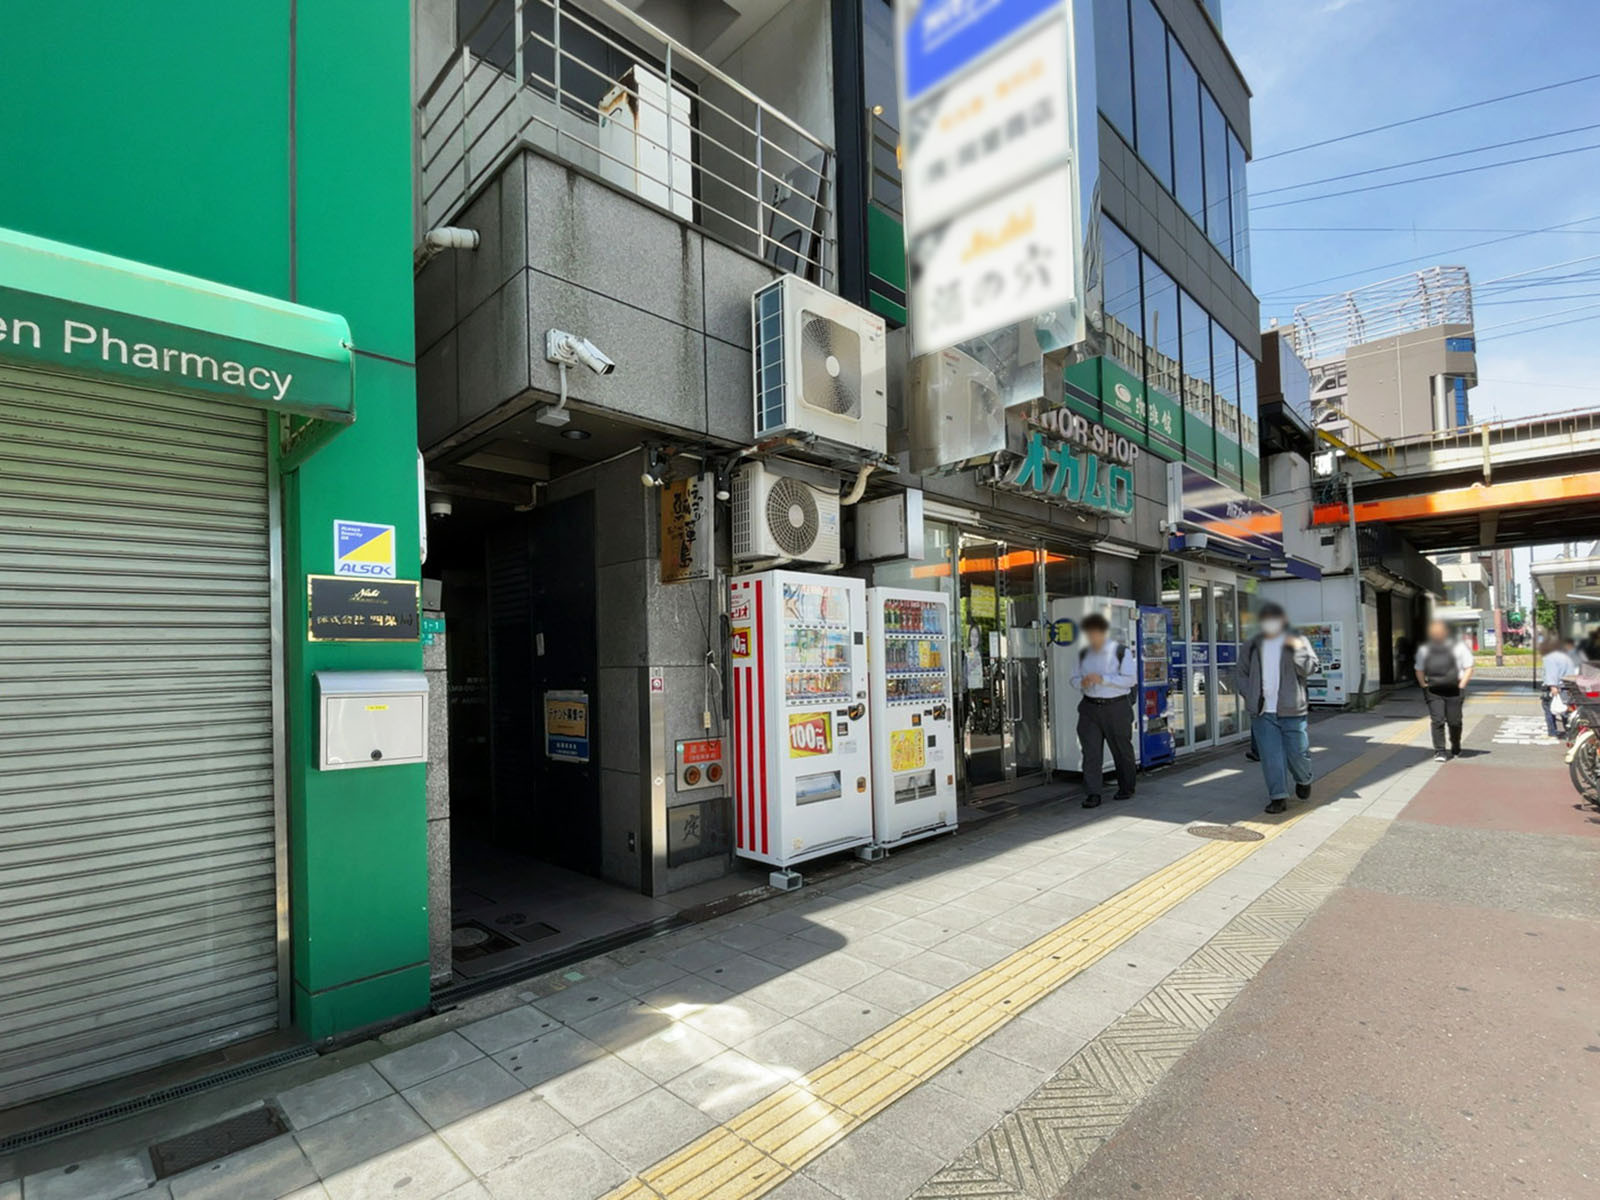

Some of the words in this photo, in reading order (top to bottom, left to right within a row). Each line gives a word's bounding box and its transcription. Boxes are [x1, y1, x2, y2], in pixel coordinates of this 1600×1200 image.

[64, 319, 293, 401] Pharmacy
[1012, 432, 1134, 516] オカムロ
[1092, 424, 1139, 465] SHOP
[339, 563, 392, 576] ALSOK
